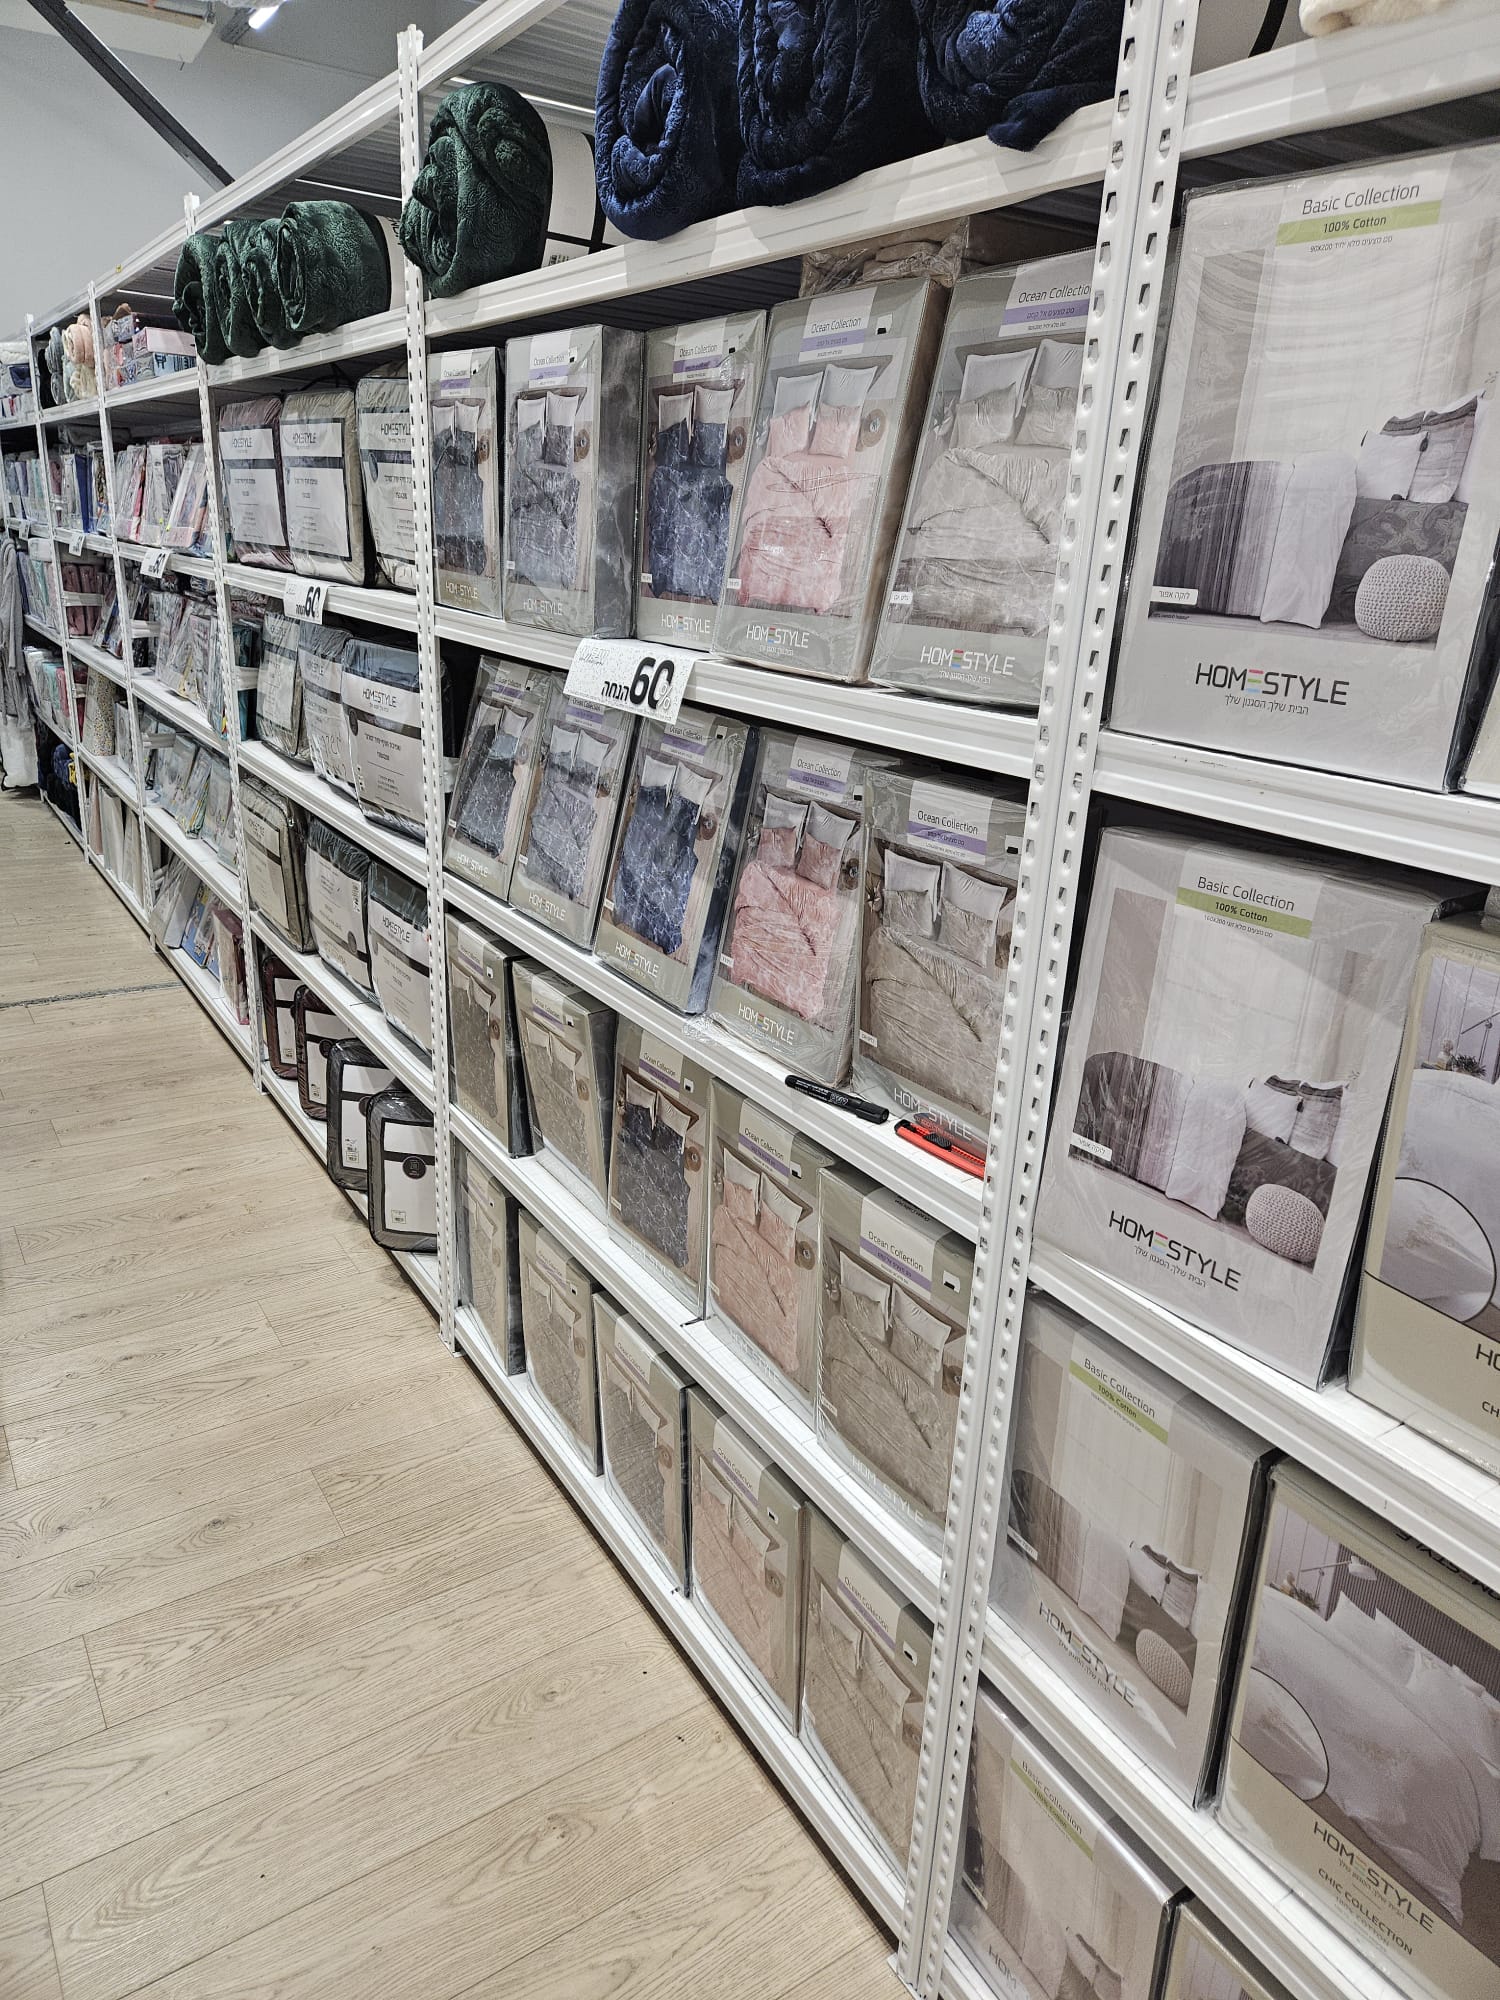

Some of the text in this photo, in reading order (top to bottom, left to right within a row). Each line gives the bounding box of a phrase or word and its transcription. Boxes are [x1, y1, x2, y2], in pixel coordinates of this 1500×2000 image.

[1302, 184, 1420, 215] Basic Collection
[1324, 216, 1387, 233] 100% Cotton
[1018, 284, 1092, 303] Ocean Collectio
[661, 613, 711, 634] HOMESTYLE
[746, 624, 809, 649] HOMESTYLE
[920, 645, 1016, 676] HOMESTYLE
[601, 680, 630, 702] הנחה
[1195, 663, 1350, 706] HOMESTYLE
[1225, 693, 1241, 707] שלך
[1242, 697, 1267, 710] הסגנון
[1288, 703, 1309, 715] הבית
[797, 759, 842, 779] Ocean Collection
[917, 810, 941, 826] Ocean
[942, 816, 978, 836] Collection
[1197, 876, 1295, 912] Basic Collection
[1215, 901, 1268, 923] 100% Cotton
[615, 941, 660, 978] HOMESTYLE
[738, 1002, 795, 1045] HOMESTYLE
[894, 1087, 973, 1141] HOMESTYLE
[744, 1128, 760, 1145] Ocean
[868, 1231, 889, 1249] Ocean
[890, 1245, 924, 1273] Collection
[1109, 1210, 1242, 1292] HOMESTYLE
[1188, 1273, 1206, 1288] הבית
[1084, 1358, 1108, 1384] Basic
[1109, 1378, 1155, 1419] Collection
[1098, 1385, 1115, 1401] 100%
[1116, 1399, 1137, 1418] Cotton
[1039, 1601, 1136, 1708] HOMESTYLE
[1022, 1760, 1042, 1787] Basic
[1044, 1785, 1082, 1834] Collection
[1313, 1821, 1434, 1934] HOMESTYLE
[1318, 1867, 1413, 1955] CHIC COLLECTION
